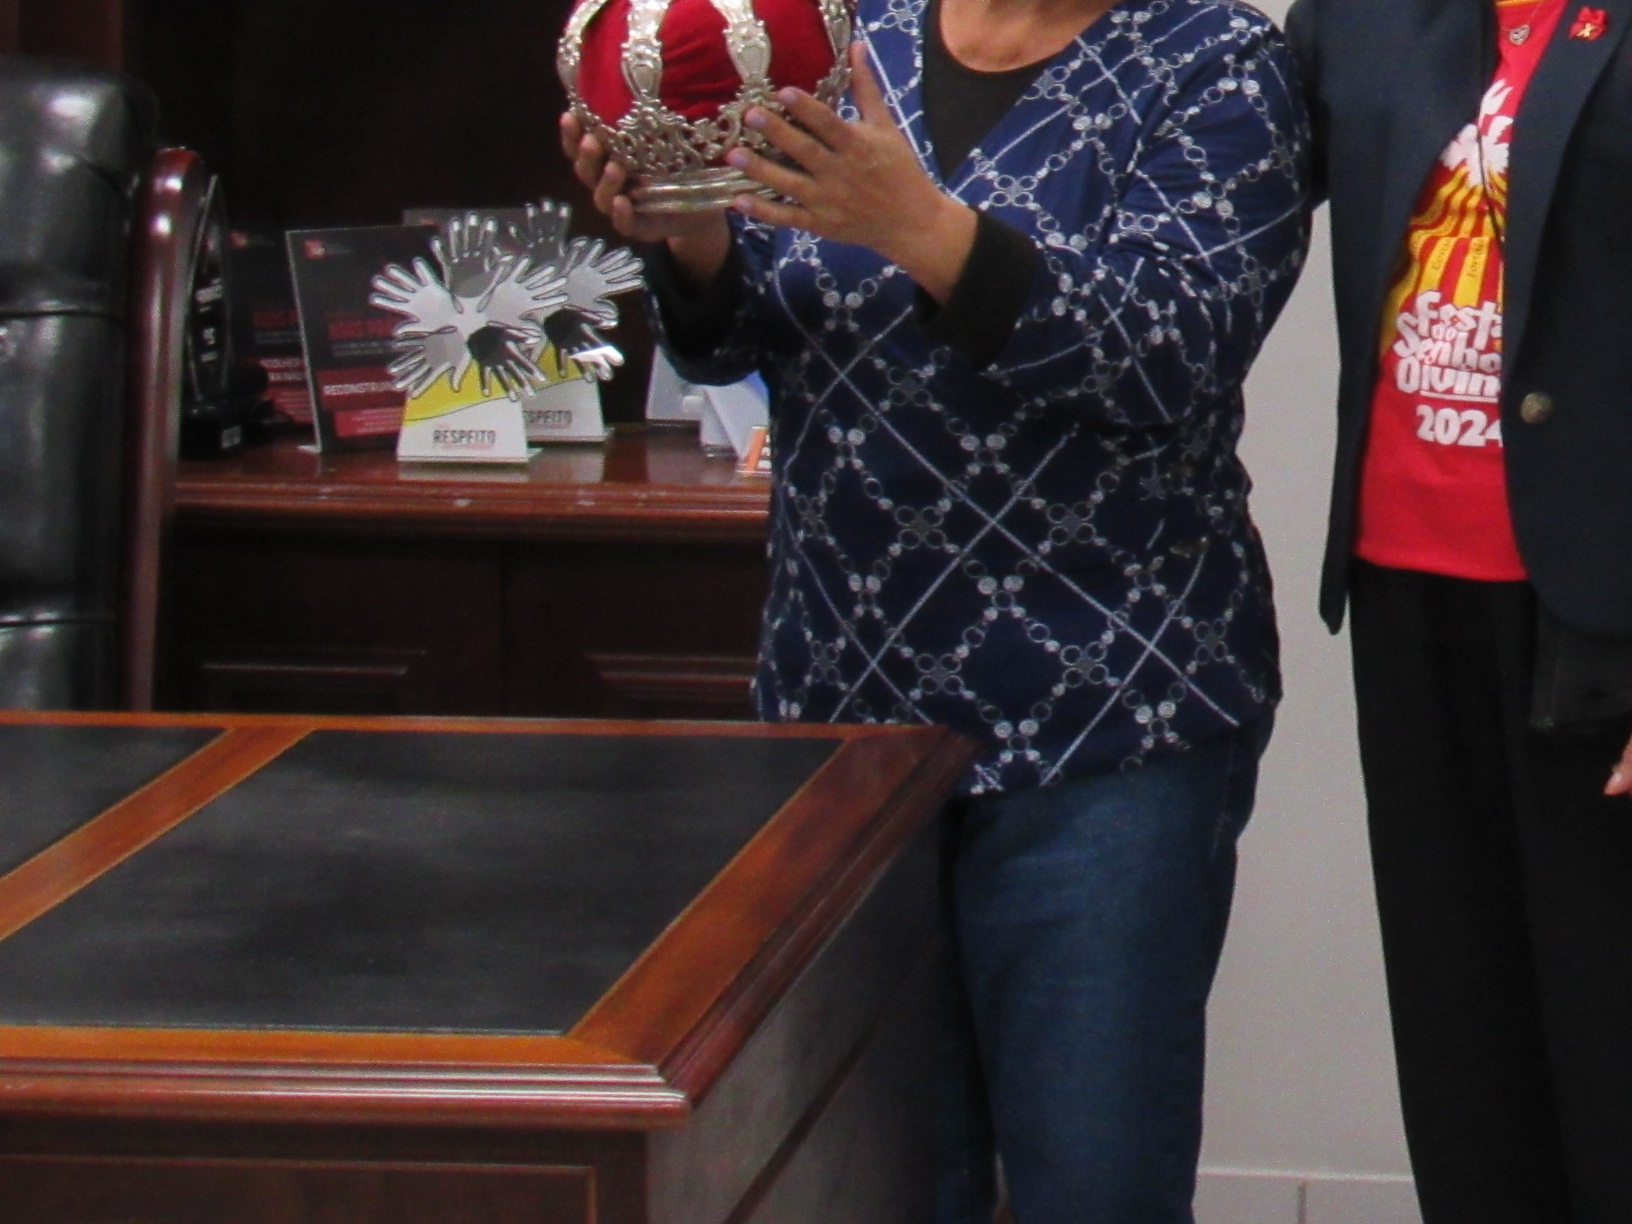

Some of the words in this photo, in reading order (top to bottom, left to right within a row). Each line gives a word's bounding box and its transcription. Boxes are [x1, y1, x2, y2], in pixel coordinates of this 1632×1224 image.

[1393, 312, 1502, 373] Senho
[1396, 357, 1502, 397] Divin
[433, 429, 496, 444] RESPEITO
